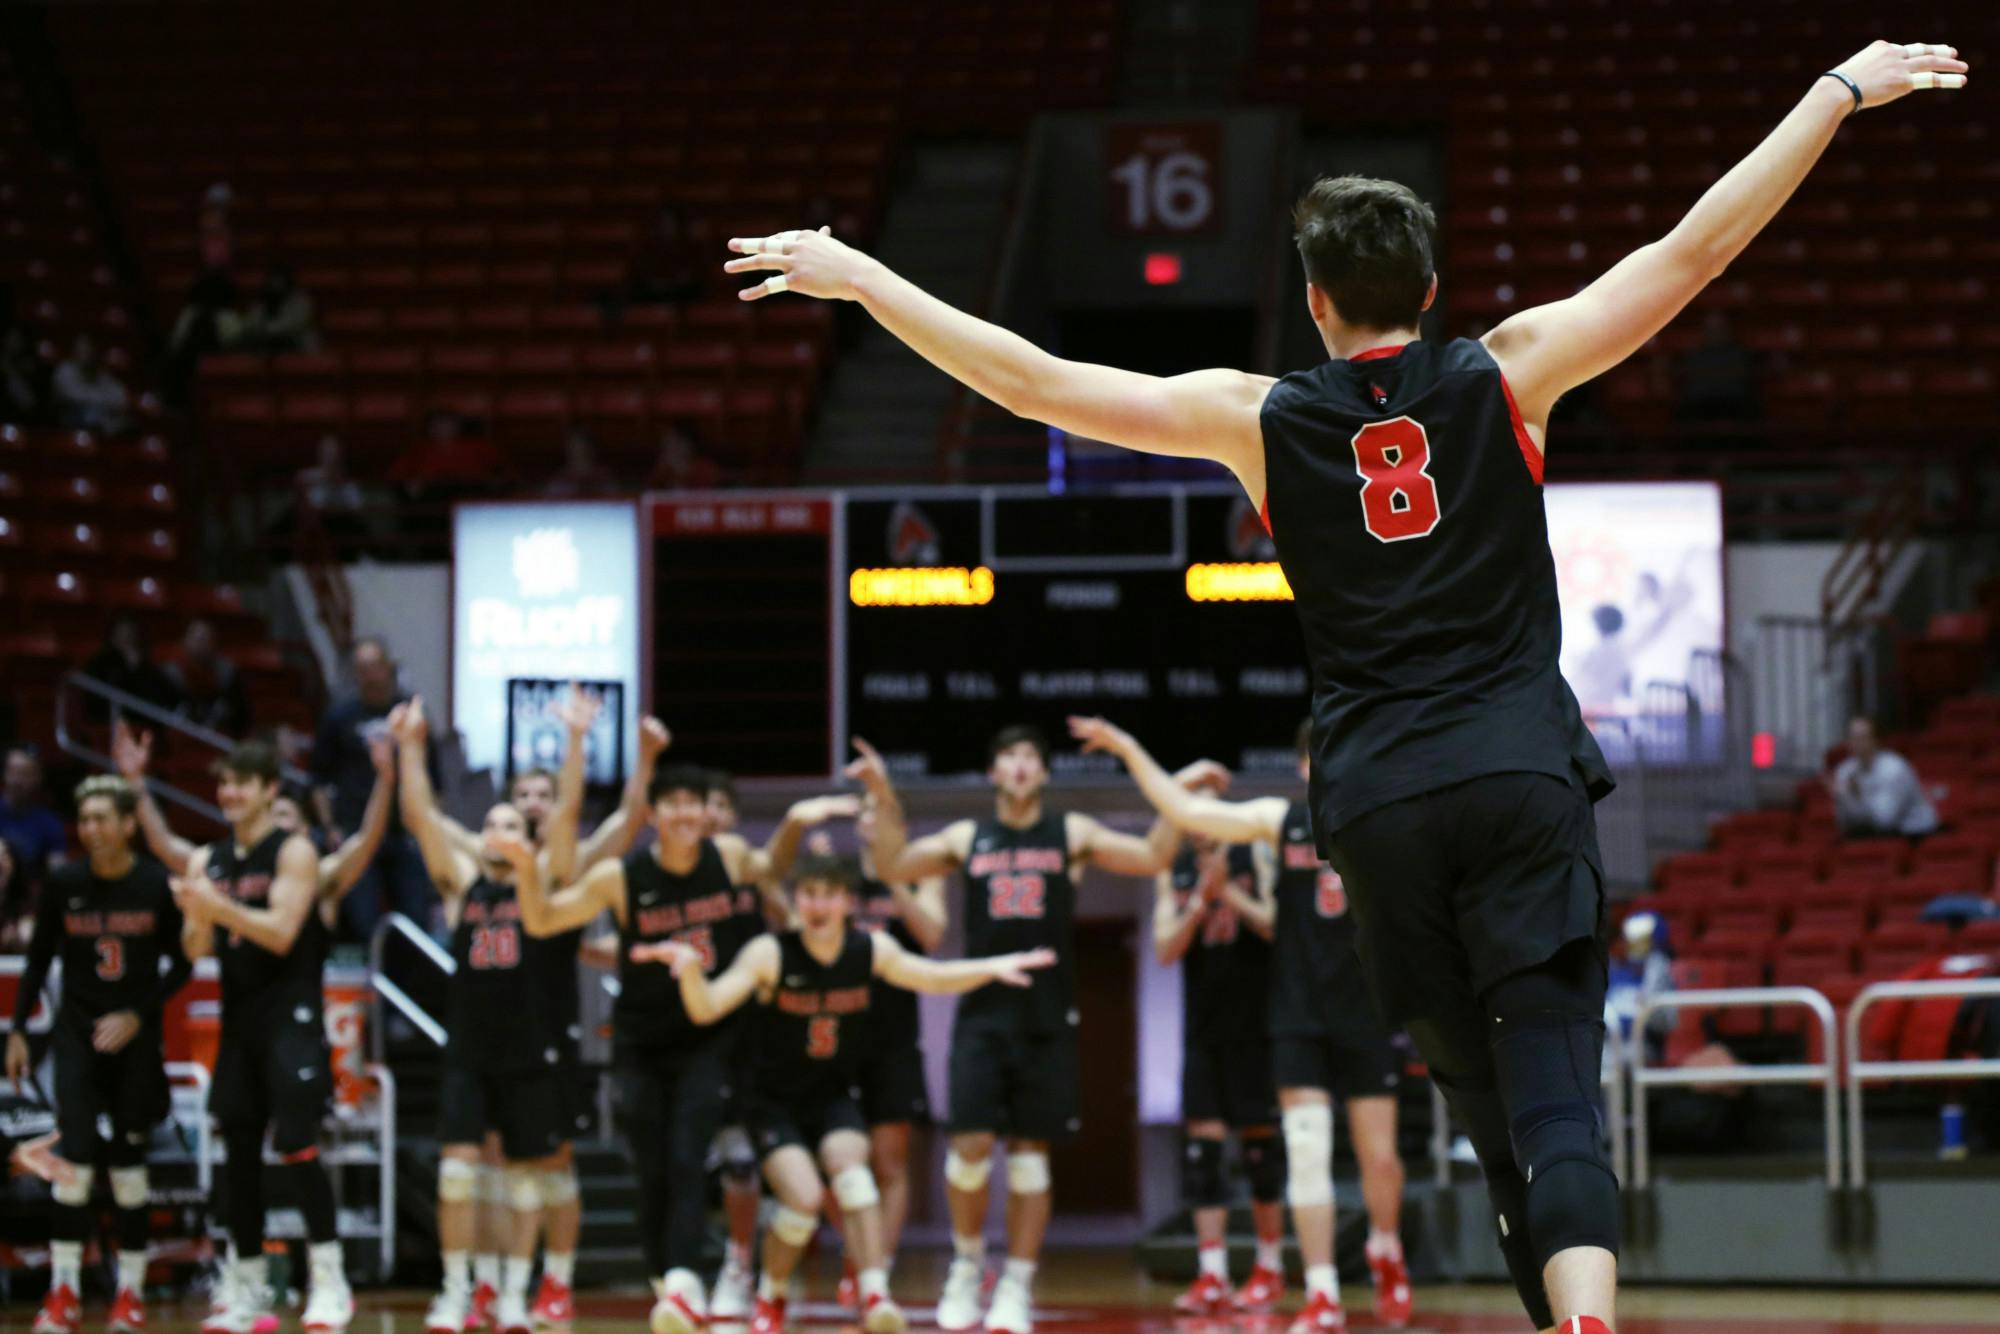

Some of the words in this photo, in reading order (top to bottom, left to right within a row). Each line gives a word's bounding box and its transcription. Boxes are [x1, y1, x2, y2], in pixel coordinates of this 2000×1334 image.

[1111, 152, 1212, 230] 16
[1350, 415, 1442, 543] 8
[986, 873, 1047, 919] 22
[95, 936, 125, 981] 3
[806, 1017, 839, 1060] 5
